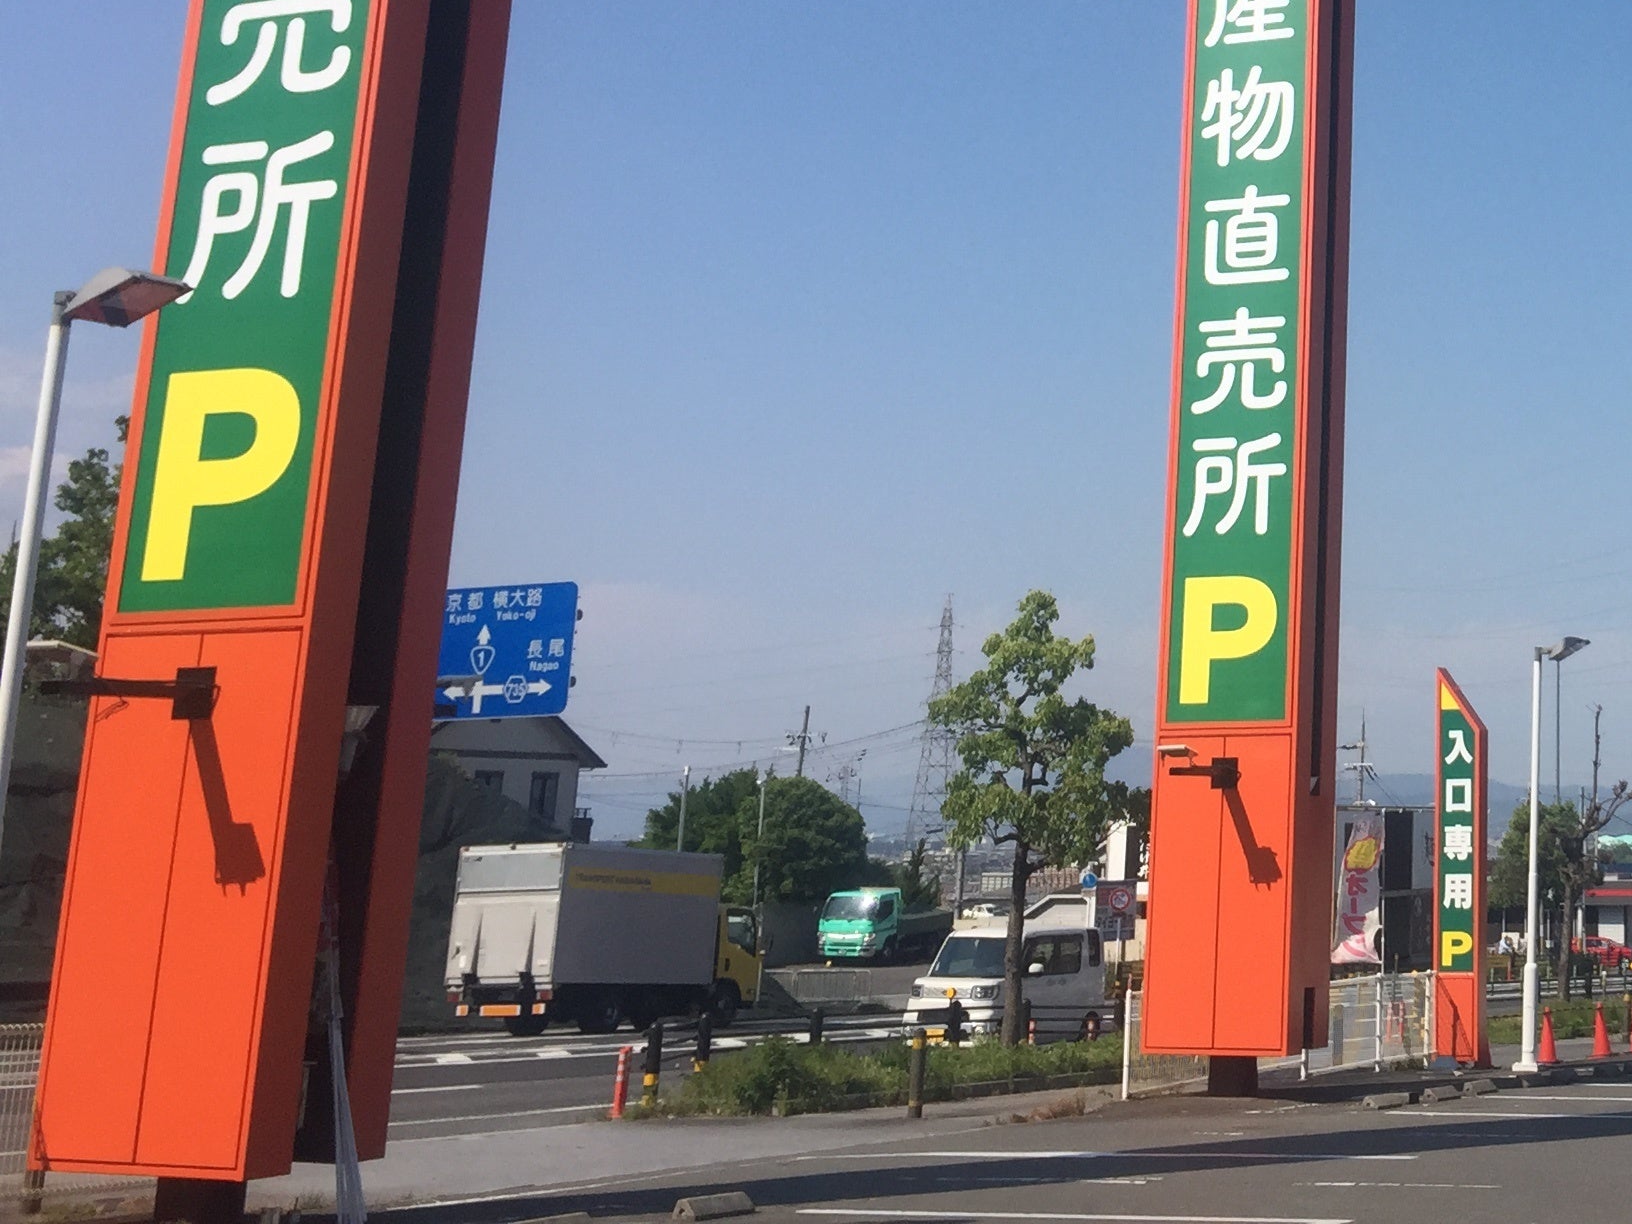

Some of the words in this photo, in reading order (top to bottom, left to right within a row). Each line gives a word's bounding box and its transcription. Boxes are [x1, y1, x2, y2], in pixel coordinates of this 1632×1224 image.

[141, 368, 301, 582] P
[446, 592, 483, 611] 京都
[493, 588, 542, 609] 横大路
[449, 613, 476, 625] Kyoto
[527, 639, 565, 659] 長尾
[1180, 577, 1277, 704] P
[1443, 729, 1473, 910] 入口専用
[1441, 930, 1473, 967] P
